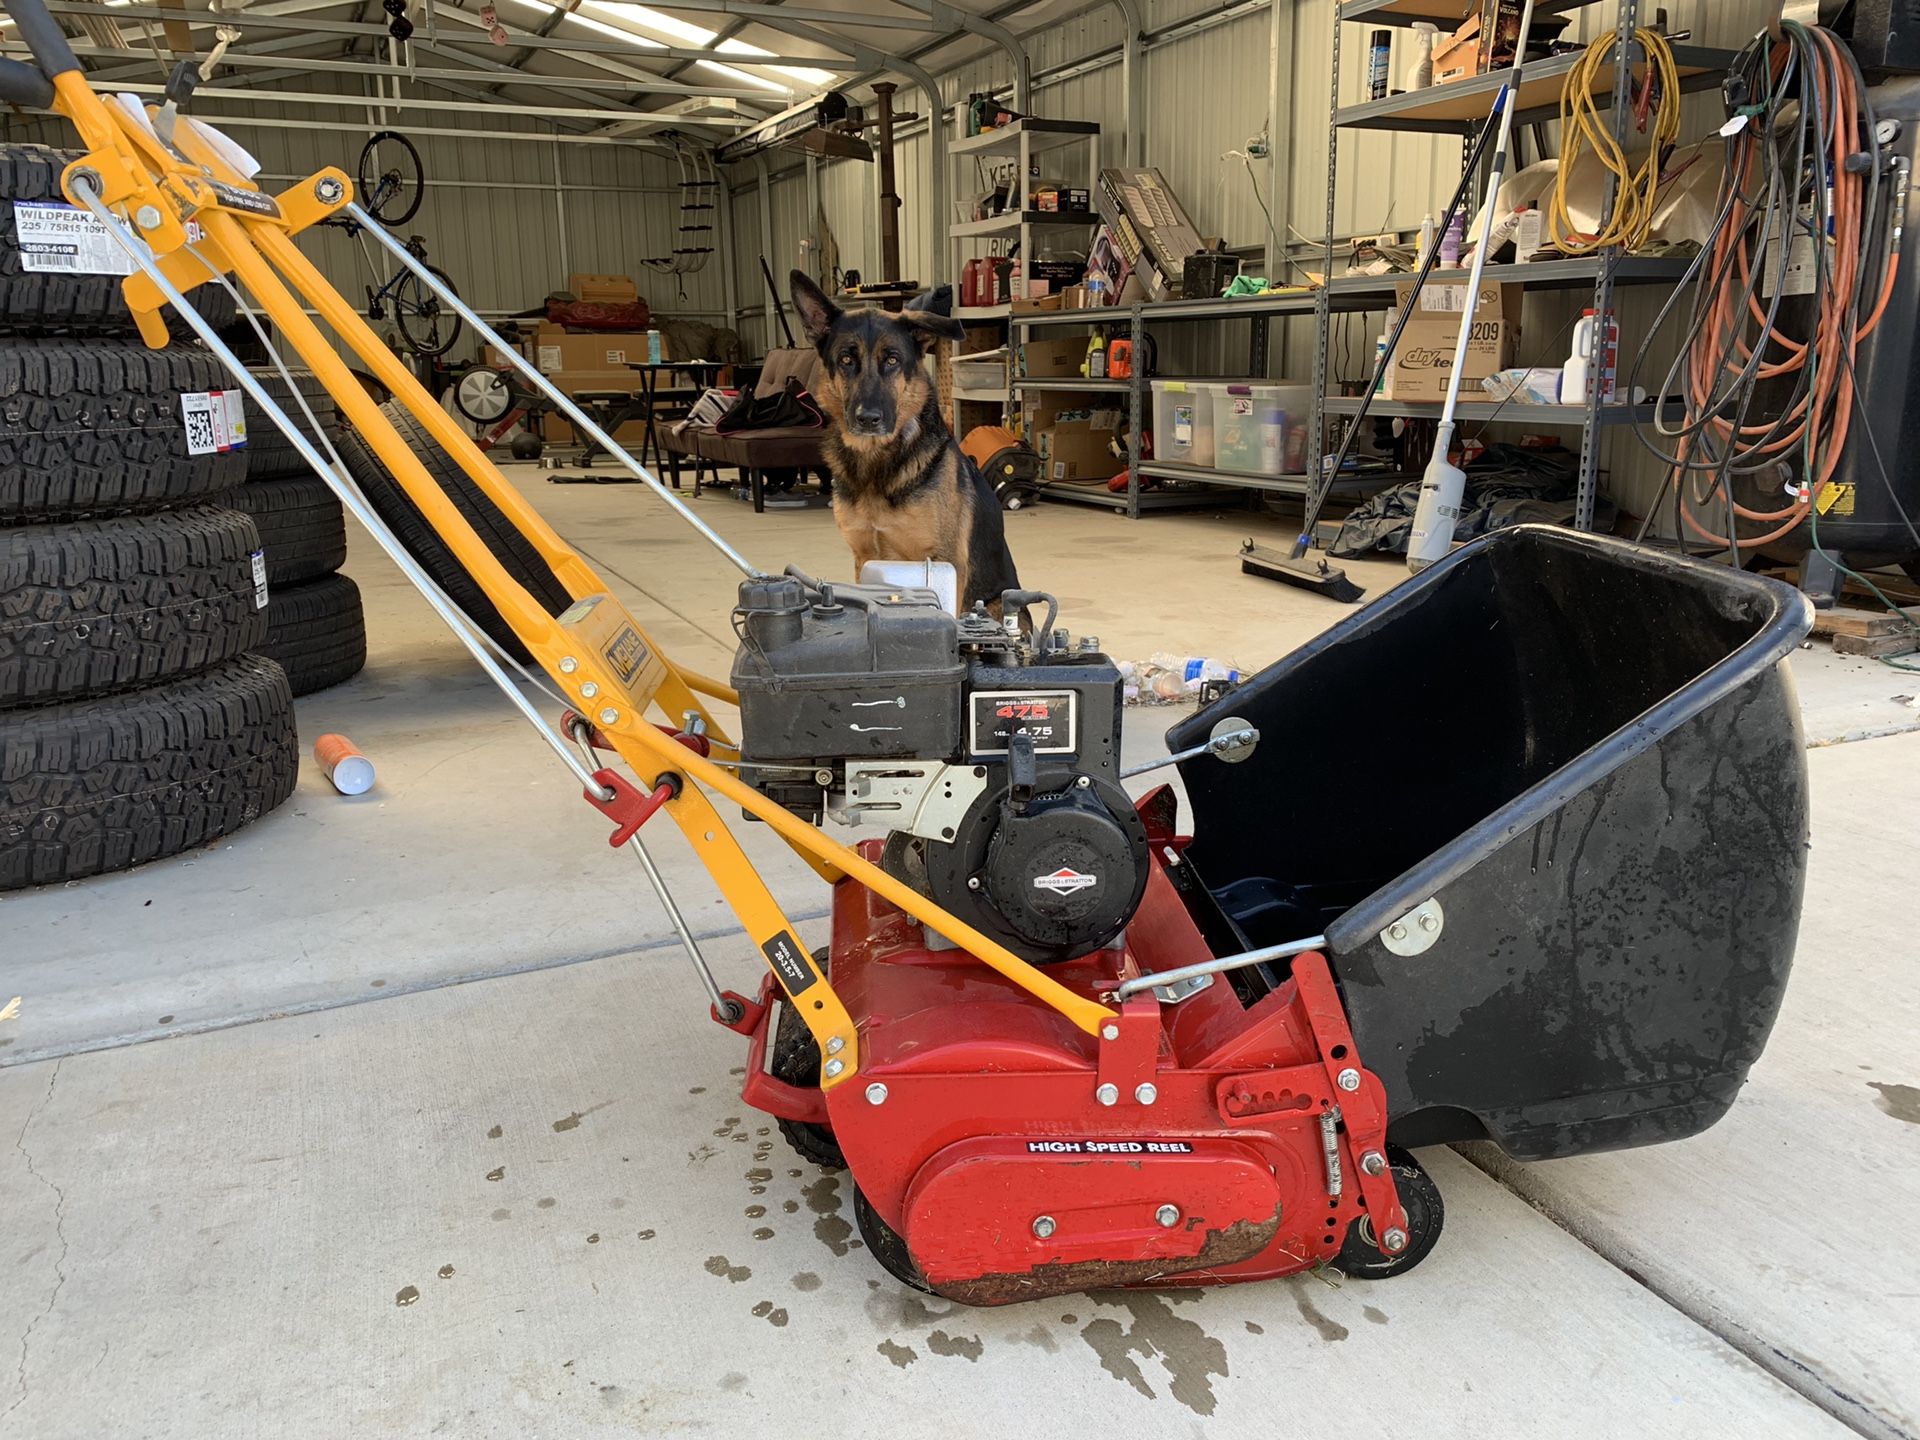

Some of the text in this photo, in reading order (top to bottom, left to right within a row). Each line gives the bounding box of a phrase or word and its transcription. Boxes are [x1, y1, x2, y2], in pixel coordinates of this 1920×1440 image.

[20, 208, 89, 223] WILDPEAK
[21, 221, 42, 231] 235
[50, 223, 81, 233] 75R15
[84, 225, 107, 234] 109T
[1459, 321, 1499, 341] 3209
[1405, 347, 1454, 368] dryte
[996, 704, 1049, 719] 475
[1016, 726, 1053, 737] 4.75
[774, 950, 796, 978] 20-3.5-7
[777, 941, 805, 980] MODEL NUMBER
[1029, 1141, 1191, 1153] HIGH SPEED REEL
